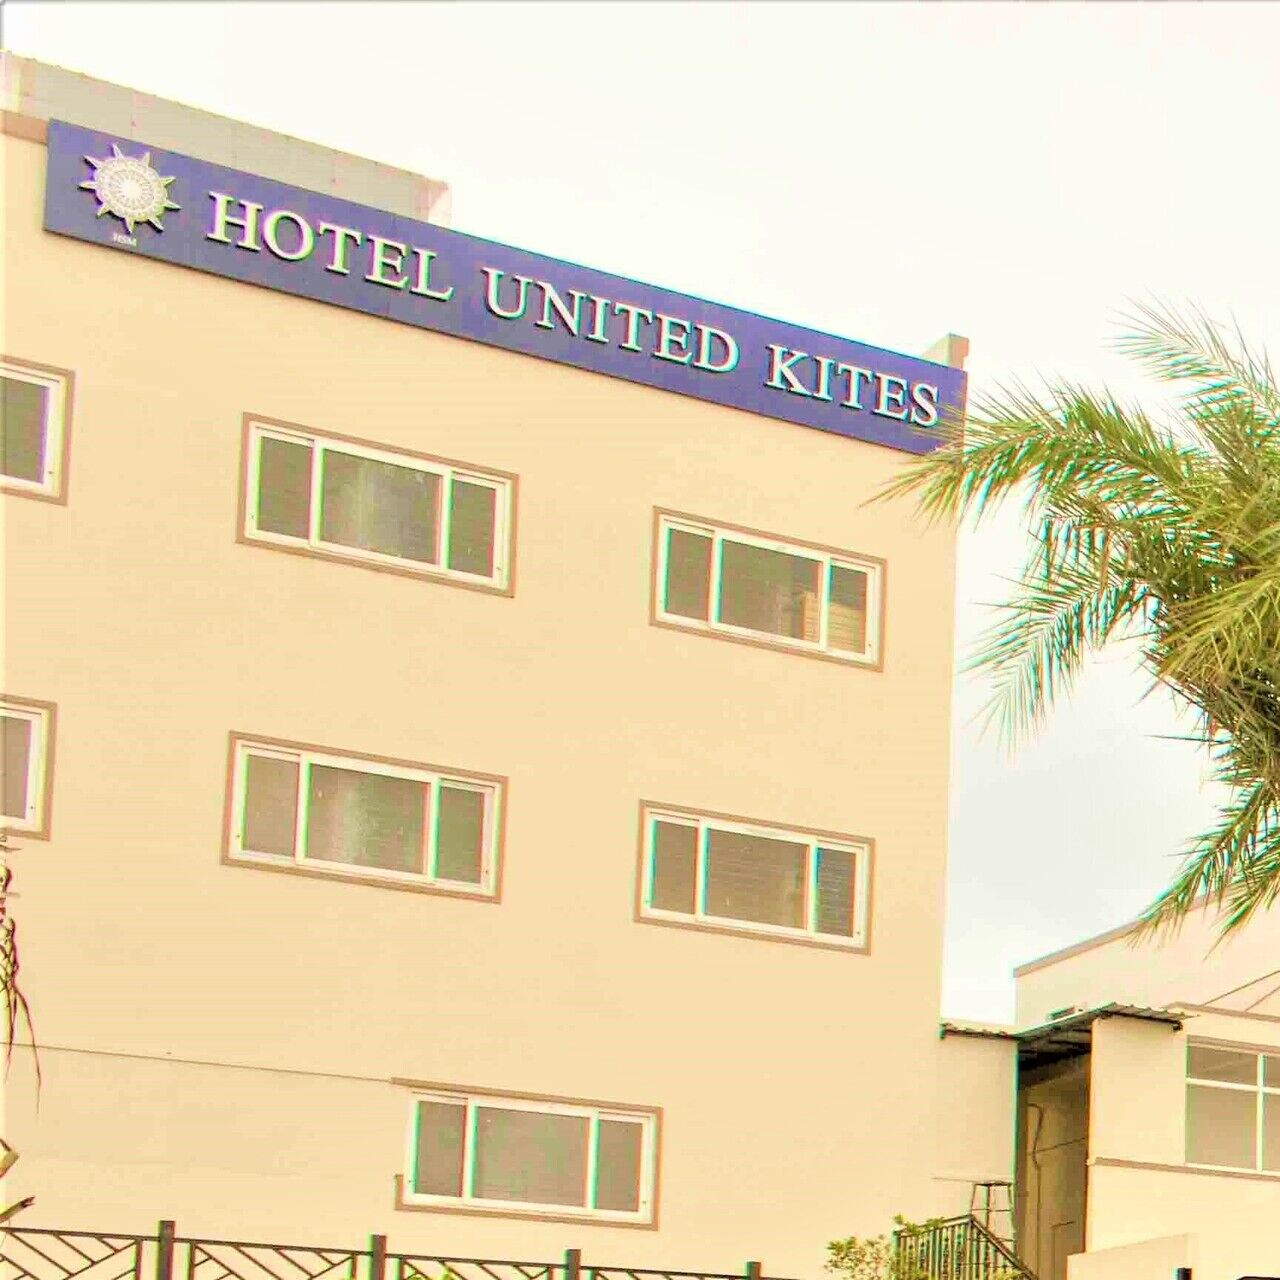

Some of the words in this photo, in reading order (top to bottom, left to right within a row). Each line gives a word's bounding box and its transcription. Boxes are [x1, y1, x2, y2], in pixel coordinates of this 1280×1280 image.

[205, 190, 455, 302] HOTEL
[481, 266, 741, 373] UNITED
[764, 343, 939, 428] KITES
